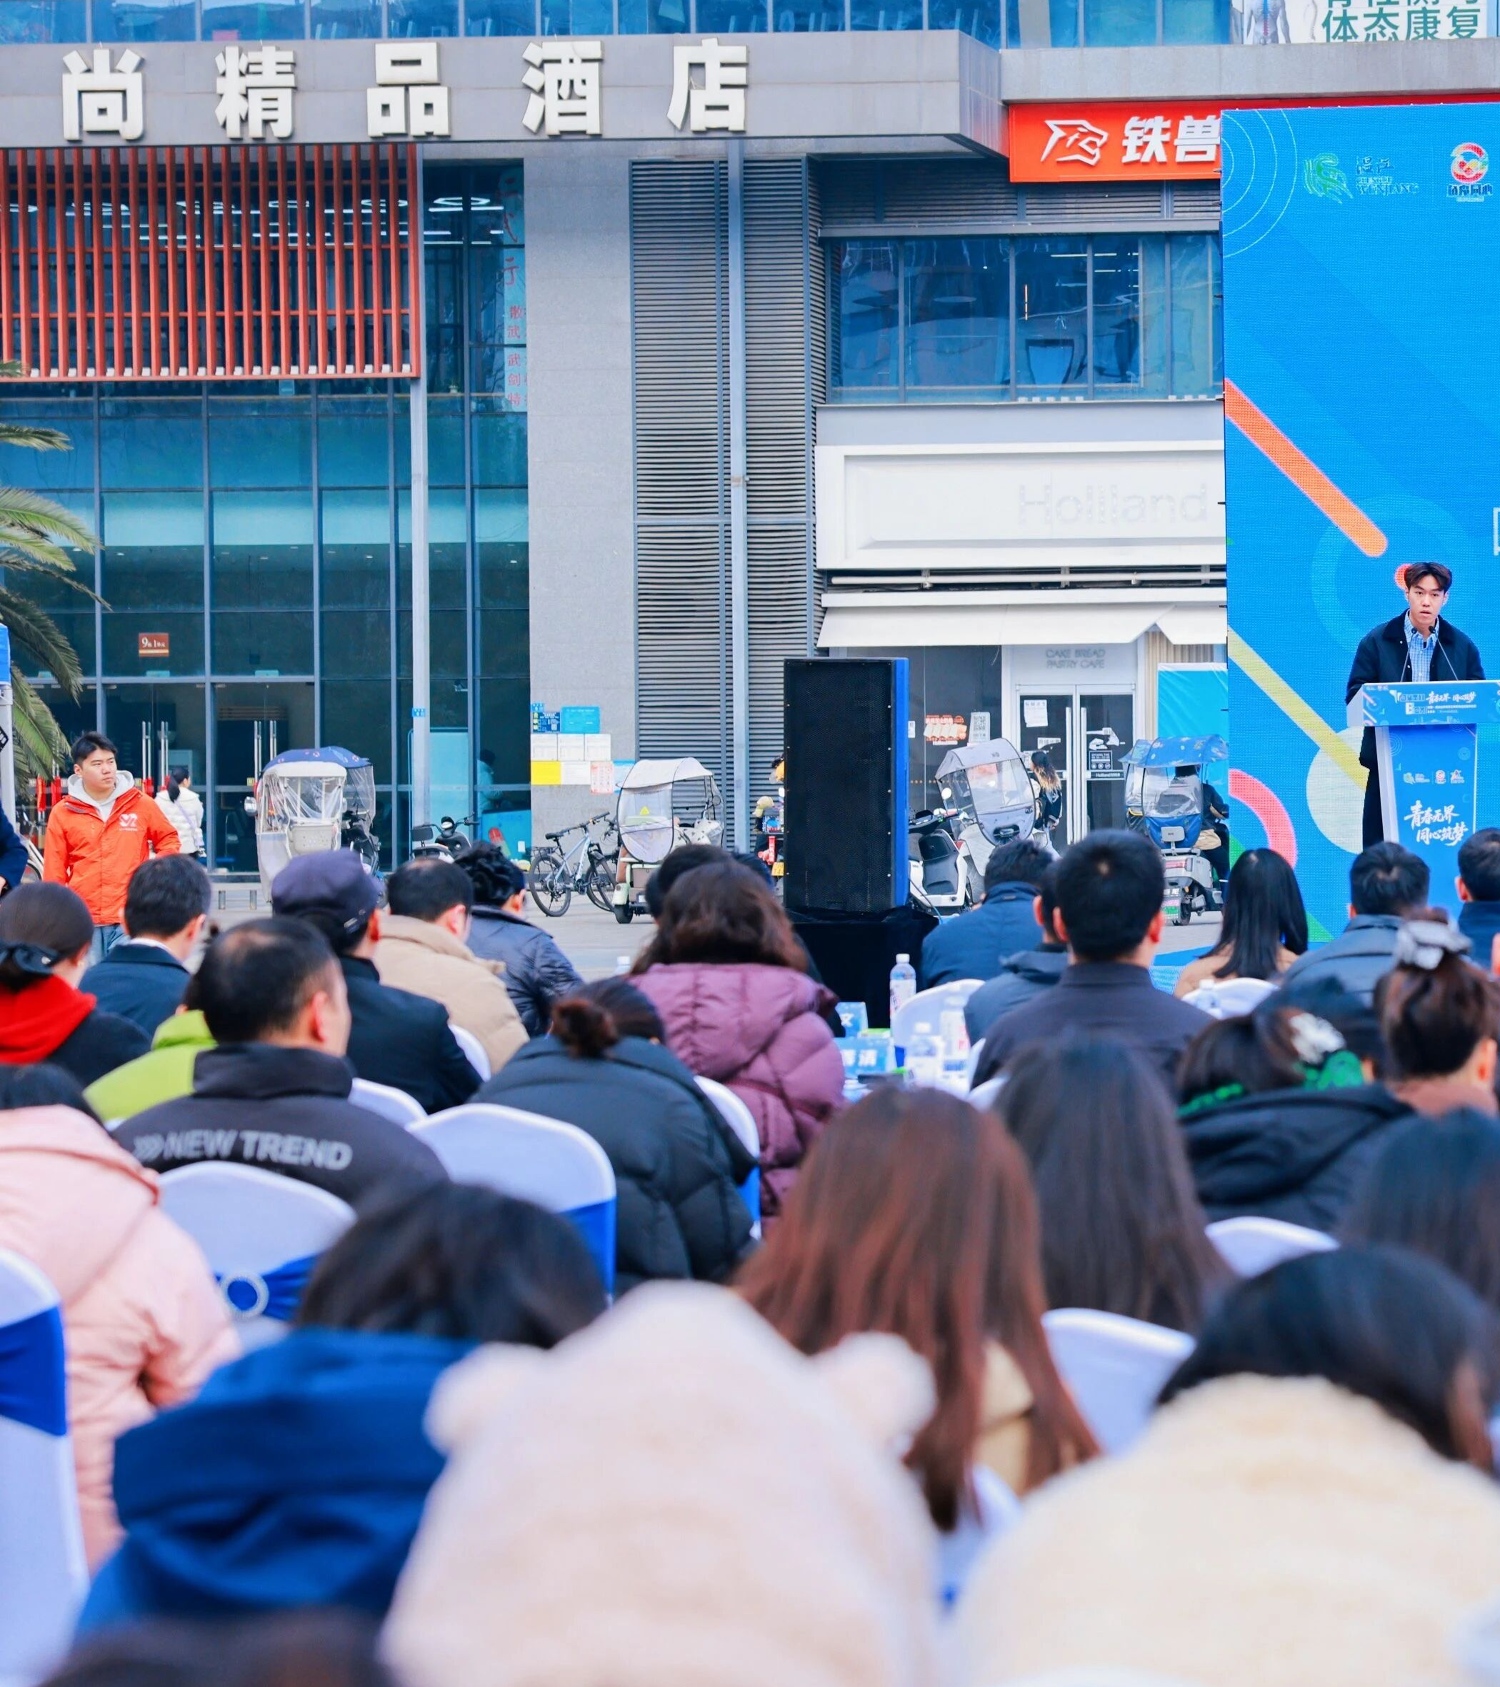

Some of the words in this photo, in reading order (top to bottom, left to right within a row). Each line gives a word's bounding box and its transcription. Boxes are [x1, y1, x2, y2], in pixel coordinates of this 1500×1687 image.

[1322, 6, 1480, 43] 体态康复
[61, 37, 748, 141] 尚精品酒店
[1122, 114, 1221, 163] 铁兽
[1046, 648, 1071, 658] CAKE
[1074, 648, 1106, 658] BREAD
[1046, 659, 1077, 669] PASTRY
[1080, 659, 1105, 669] CAFE
[1404, 800, 1460, 831] 青春无界
[1416, 823, 1469, 847] 同心筑梦
[164, 1129, 238, 1160] NEW
[239, 1130, 353, 1171] TREND
